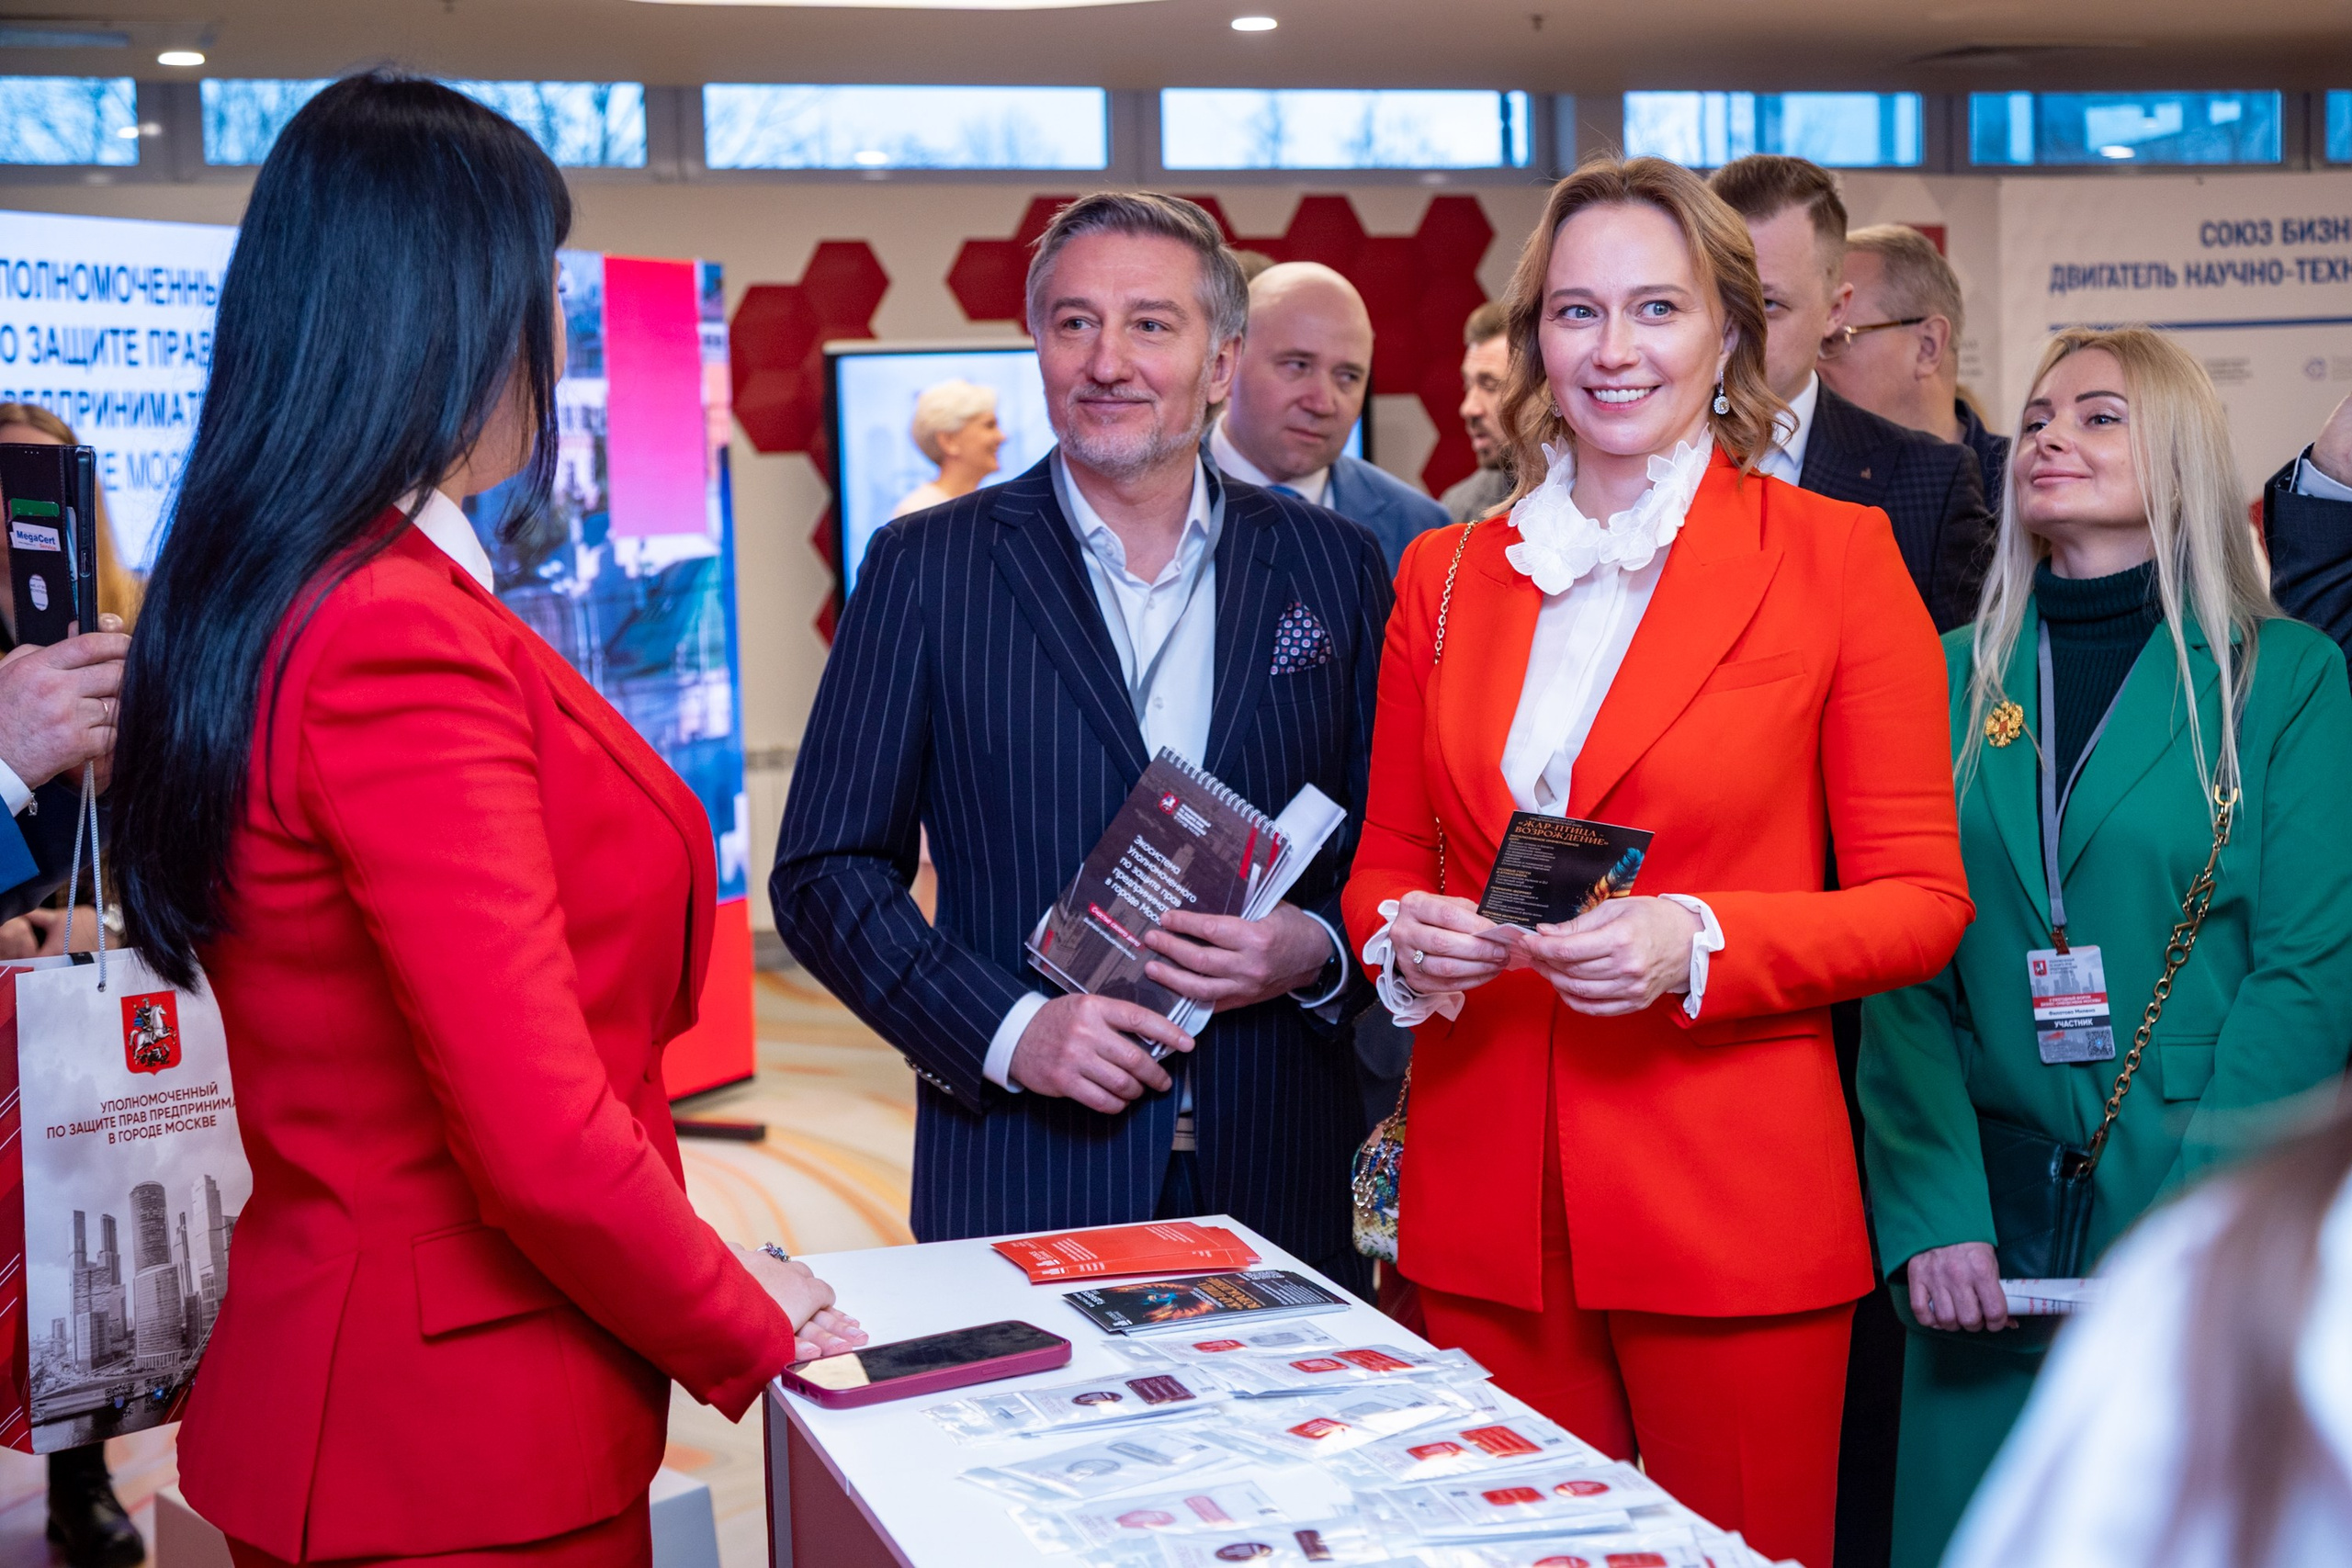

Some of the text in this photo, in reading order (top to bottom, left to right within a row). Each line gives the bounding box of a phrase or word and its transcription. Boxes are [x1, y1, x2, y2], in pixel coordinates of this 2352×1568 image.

[2200, 217, 2352, 248] СОЮЗ БИЗН
[0, 259, 223, 306] ПОЛНОМОЧЕННЫ
[2049, 256, 2352, 296] ДВИГАТЕЛЬ НАУЧНО-ТЕХН
[0, 323, 211, 374] О ЗАЩИТЕ ПРАВ
[16, 530, 56, 546] MegaCert
[1126, 845, 1197, 903] Уполномоченного
[1133, 834, 1181, 874] Экосистема
[1104, 877, 1161, 927] в городе Моск
[1112, 867, 1170, 913] предпринимат
[1119, 856, 1182, 908] по защите прав
[2053, 1018, 2094, 1028] УЧАСТНИК
[100, 1081, 219, 1113] УПОЛНОМОЧЕННЫЙ
[47, 1097, 236, 1140] ПО ЗАЩИТЕ ПРАВ ПРЕДПРИНИМ
[108, 1115, 217, 1145] В ГОРОДЕ МОСКВЕ
